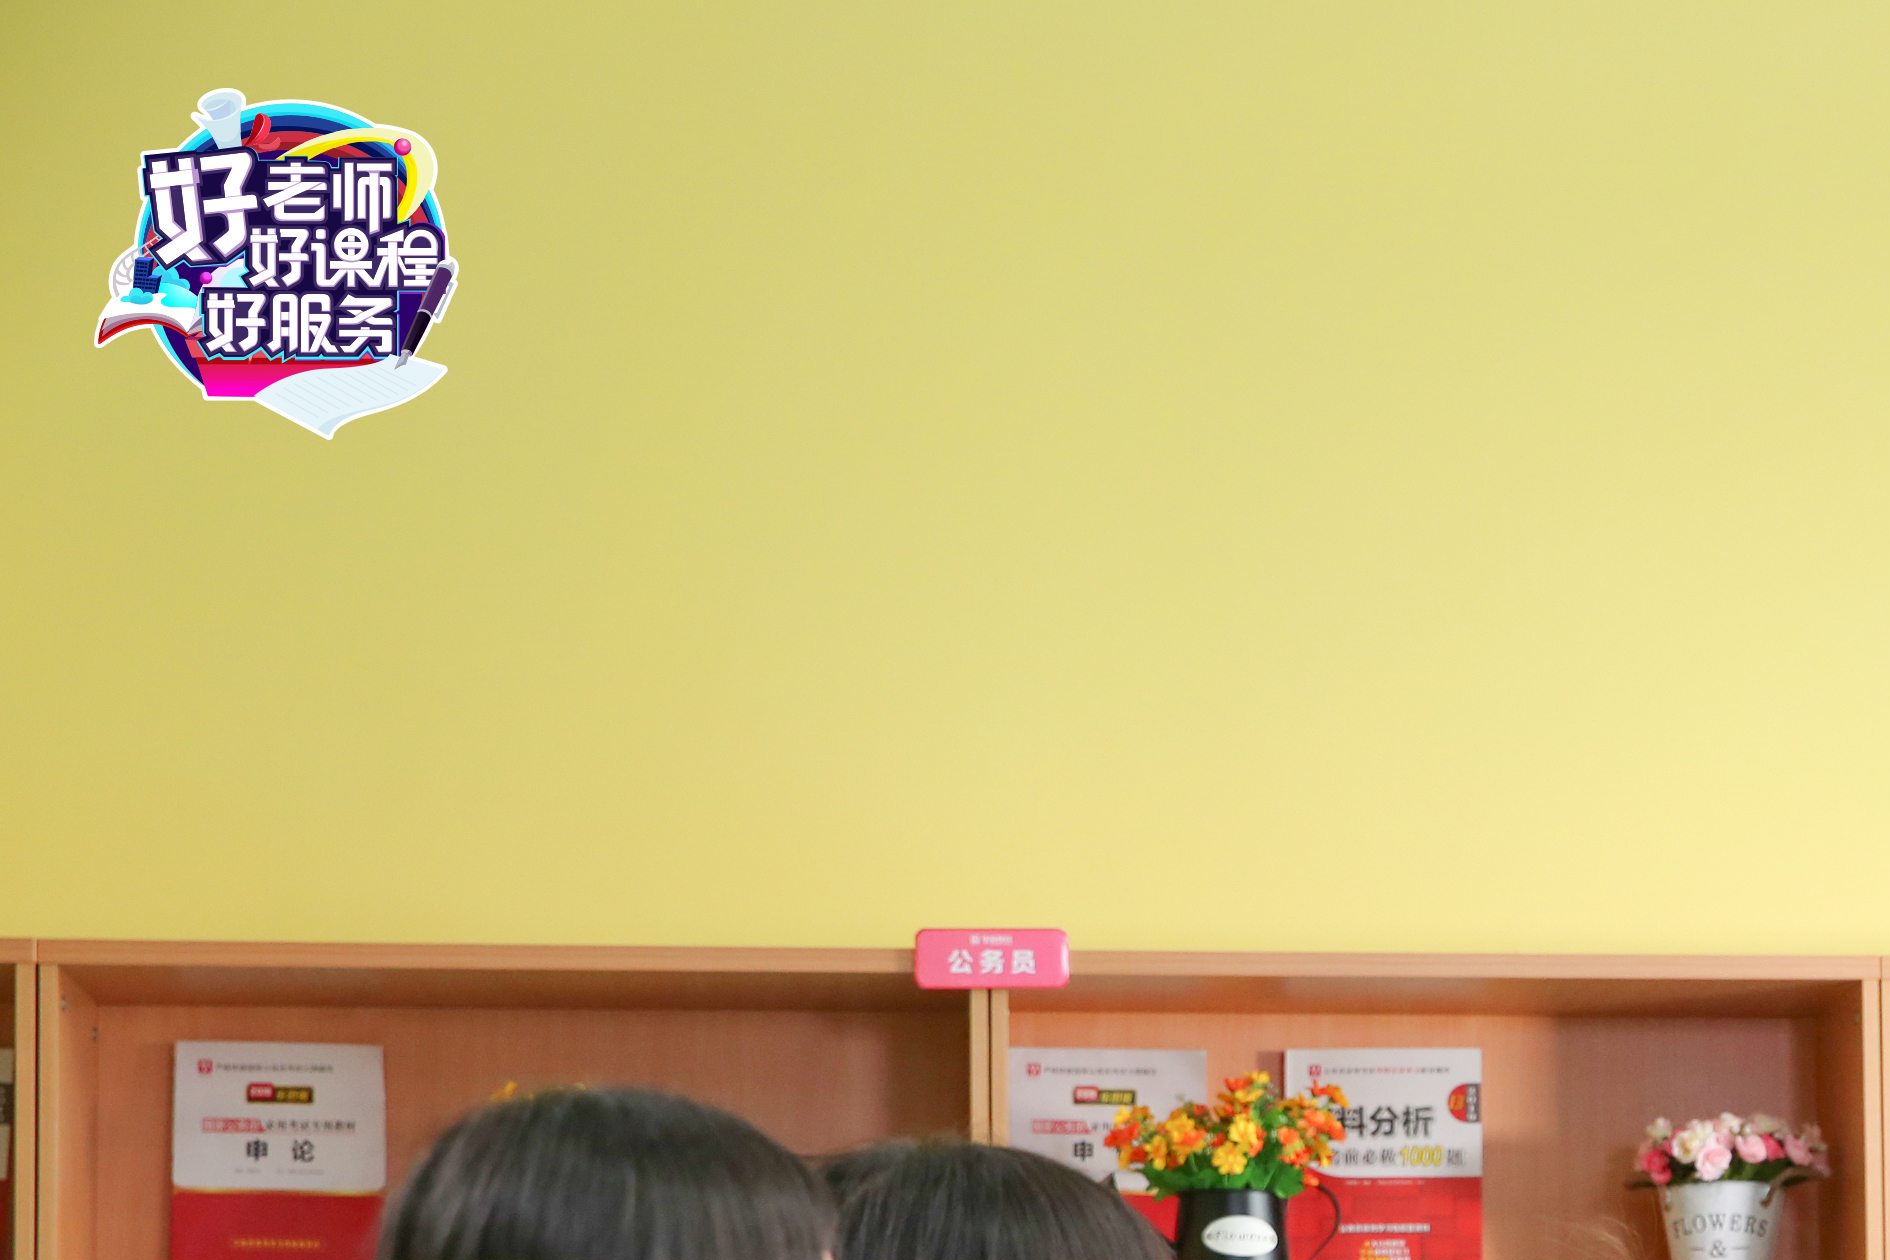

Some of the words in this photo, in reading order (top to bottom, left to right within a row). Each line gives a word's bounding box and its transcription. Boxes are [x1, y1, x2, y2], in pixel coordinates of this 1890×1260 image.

[948, 949, 1037, 975] 公务员
[246, 1138, 315, 1163] 申论
[1673, 1213, 1769, 1239] FLOWERS
[1709, 1240, 1727, 1258] &
